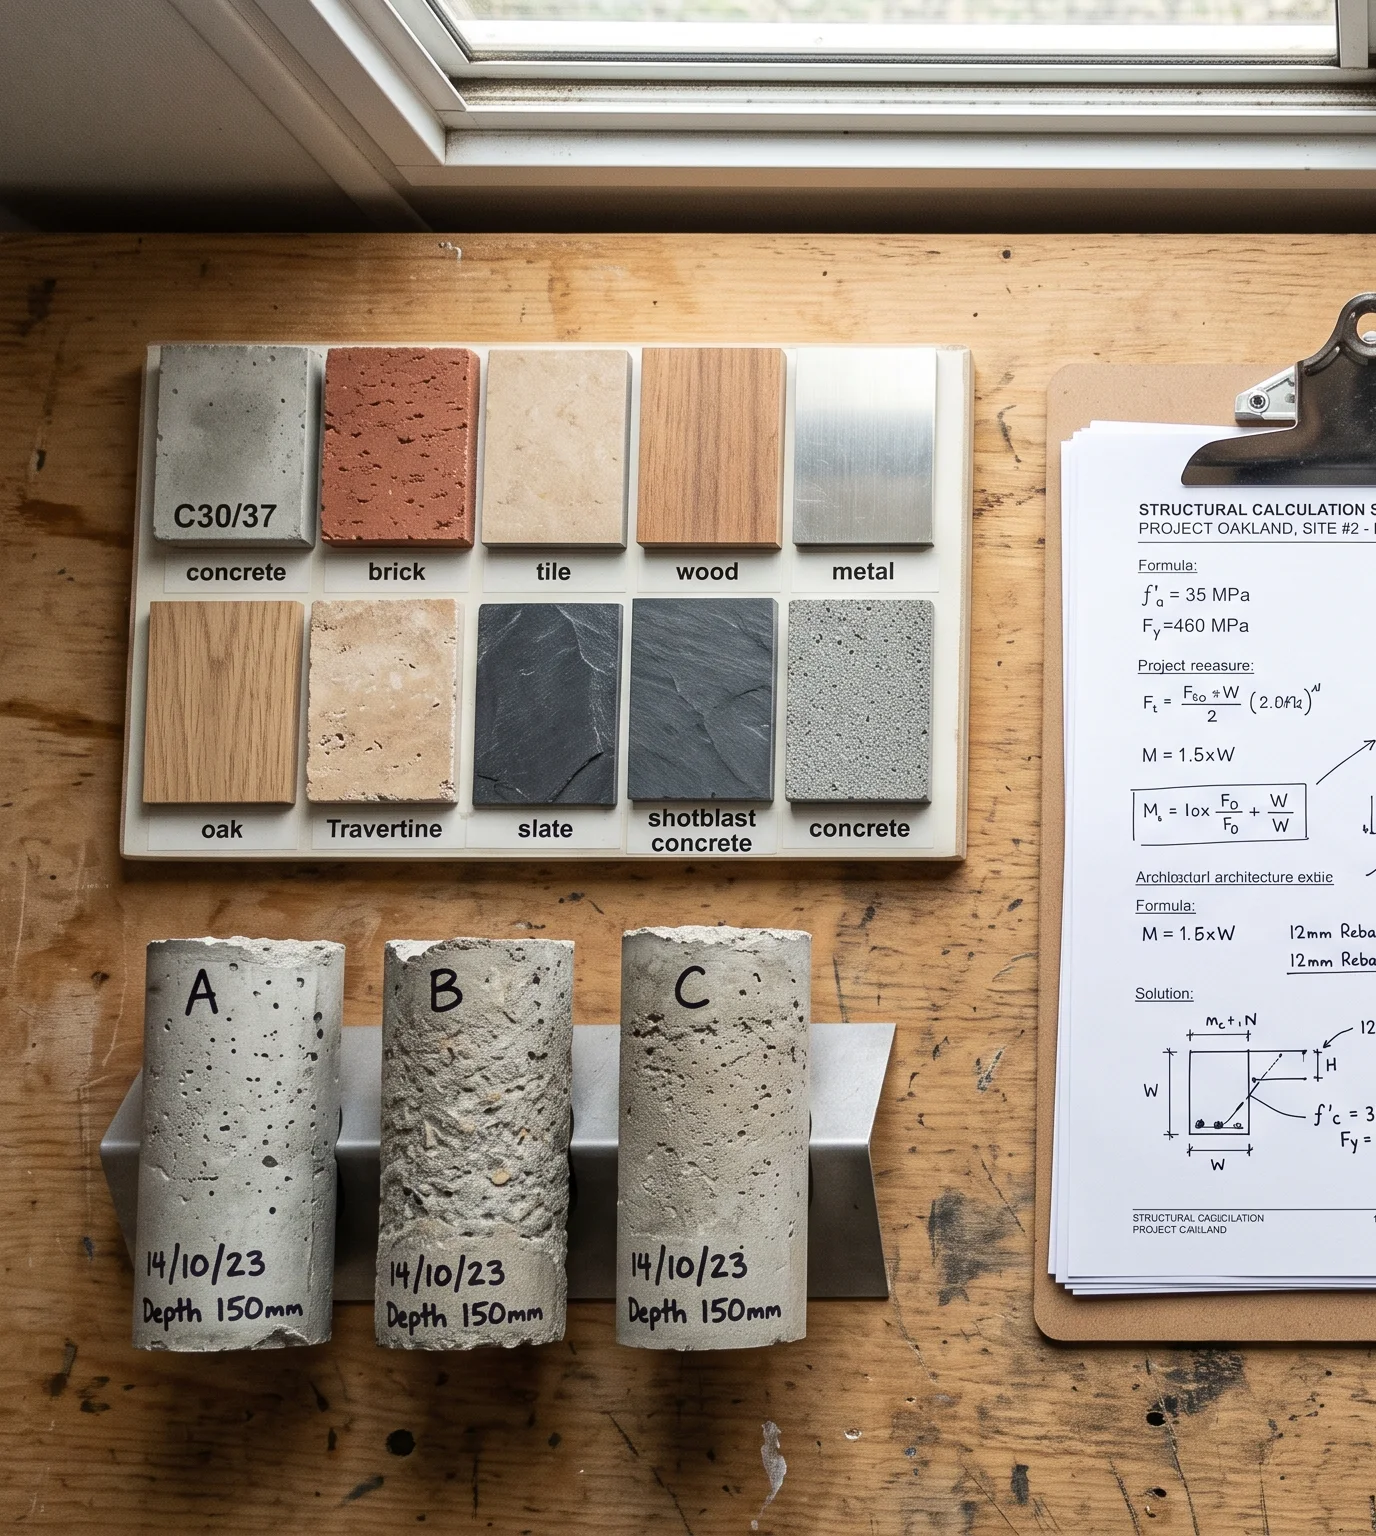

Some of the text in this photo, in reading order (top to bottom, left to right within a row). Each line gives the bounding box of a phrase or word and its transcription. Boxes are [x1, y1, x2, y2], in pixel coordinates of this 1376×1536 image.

[173, 502, 278, 529] C30/37
[1139, 503, 1248, 516] STRUCTURAL
[1252, 503, 1365, 516] CALCULATION
[1139, 522, 1213, 535] PROJECT
[1217, 522, 1297, 536] OAKLAND,
[1302, 521, 1337, 535] SITE
[1341, 522, 1359, 535] #2
[185, 561, 287, 582] concrete
[367, 561, 427, 581] brick
[536, 561, 571, 581] tile
[675, 561, 739, 581] wood
[832, 561, 894, 581] metal
[1138, 559, 1197, 571] Formula:
[1185, 587, 1206, 602] 35
[1212, 587, 1250, 602] MPa
[1211, 618, 1249, 633] MPa
[1137, 659, 1188, 675] Project
[1207, 709, 1218, 723] 2
[1142, 747, 1157, 763] M
[1269, 793, 1288, 808] W
[647, 808, 757, 829] shotblast
[1272, 818, 1290, 833] W
[200, 819, 244, 839] oak
[326, 818, 443, 839] Travertine
[517, 818, 573, 838] slate
[809, 819, 911, 838] concrete
[651, 833, 753, 853] concrete
[1214, 870, 1294, 883] architecture
[1136, 899, 1195, 912] Formula:
[1142, 926, 1158, 942] M
[1290, 924, 1332, 940] 12mm
[1290, 953, 1333, 968] 12mm
[185, 968, 220, 1018] A
[430, 968, 463, 1013] B
[674, 965, 711, 1010] C
[1135, 987, 1194, 1000] Solution:
[1326, 1057, 1337, 1072] H
[1143, 1083, 1159, 1098] W
[1210, 1158, 1225, 1171] W
[1132, 1213, 1195, 1223] STRUCTURAL
[1132, 1225, 1177, 1234] PROJECT
[146, 1243, 267, 1286] 14/10/23
[389, 1254, 506, 1292] 14/10/23
[630, 1245, 748, 1287] 14/10/23
[142, 1295, 304, 1324] Depth 150mm
[386, 1302, 544, 1329] Depth 150mm
[628, 1297, 782, 1325] Depth 150mm
